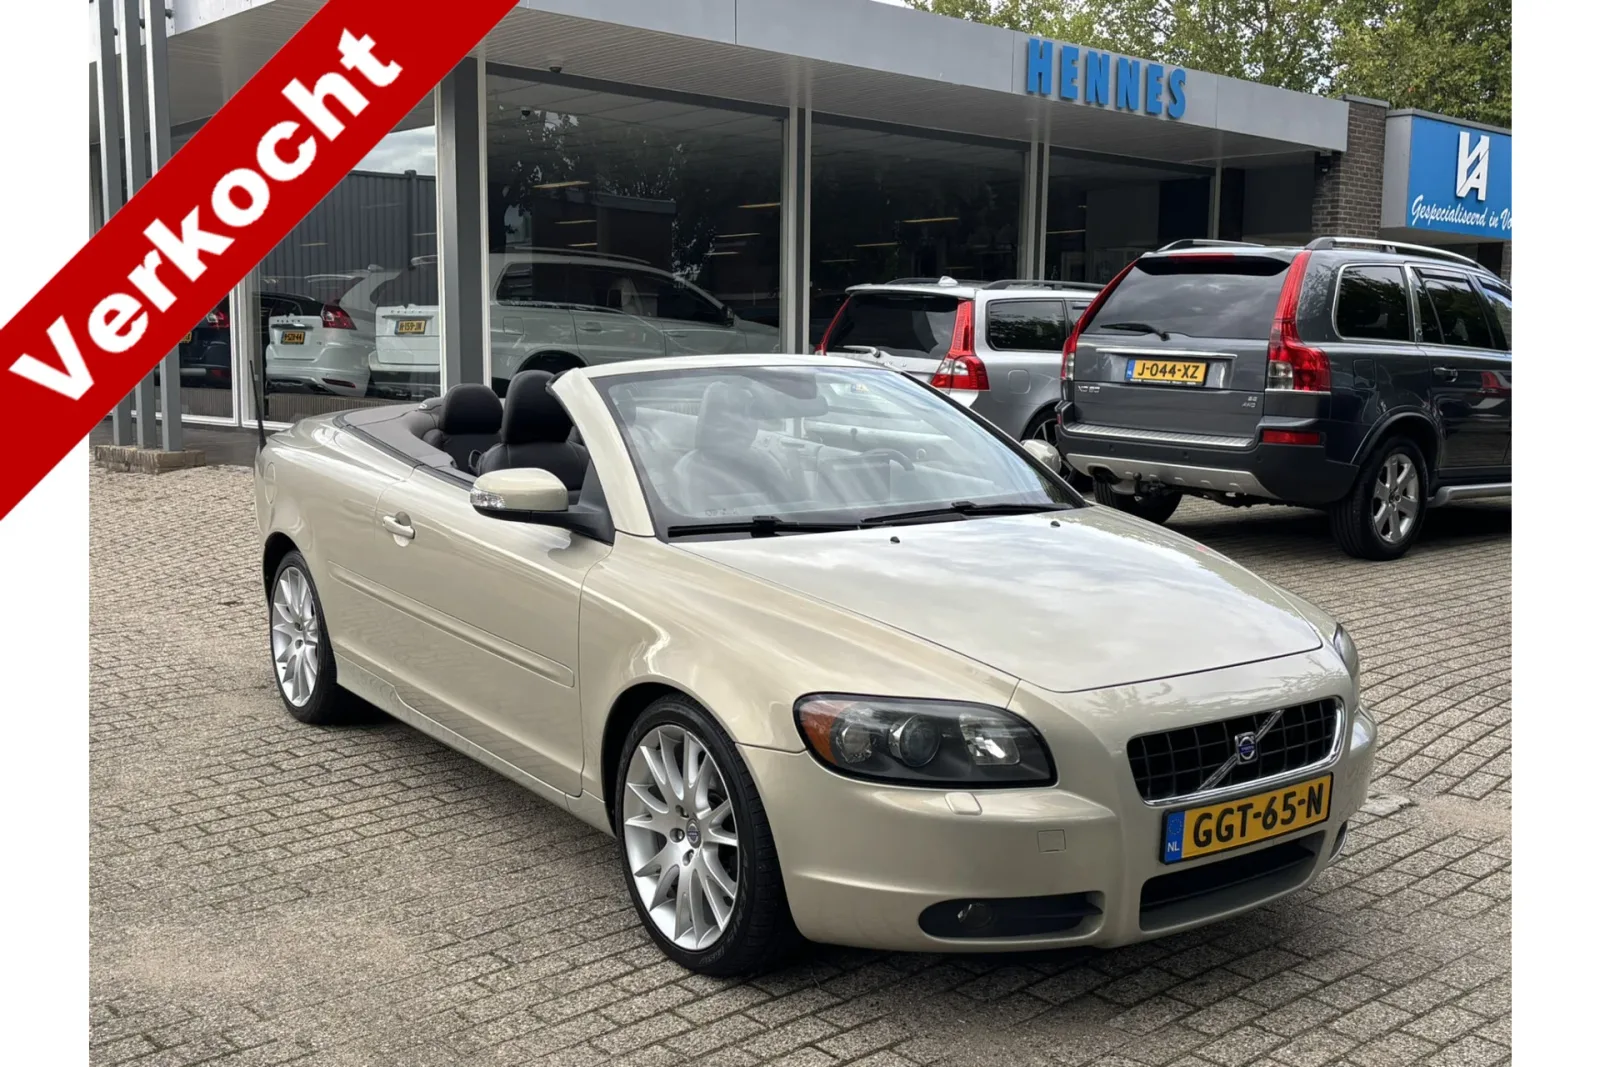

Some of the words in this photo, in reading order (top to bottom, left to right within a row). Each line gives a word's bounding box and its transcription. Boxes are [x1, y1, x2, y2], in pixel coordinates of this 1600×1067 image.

[1027, 38, 1187, 118] HENNES
[1411, 194, 1488, 226] Gespecialiseerd
[1488, 210, 1499, 228] in
[1137, 362, 1200, 379] J-044-XZ
[1193, 783, 1324, 848] GGT-65-N
[1166, 841, 1180, 852] NL
